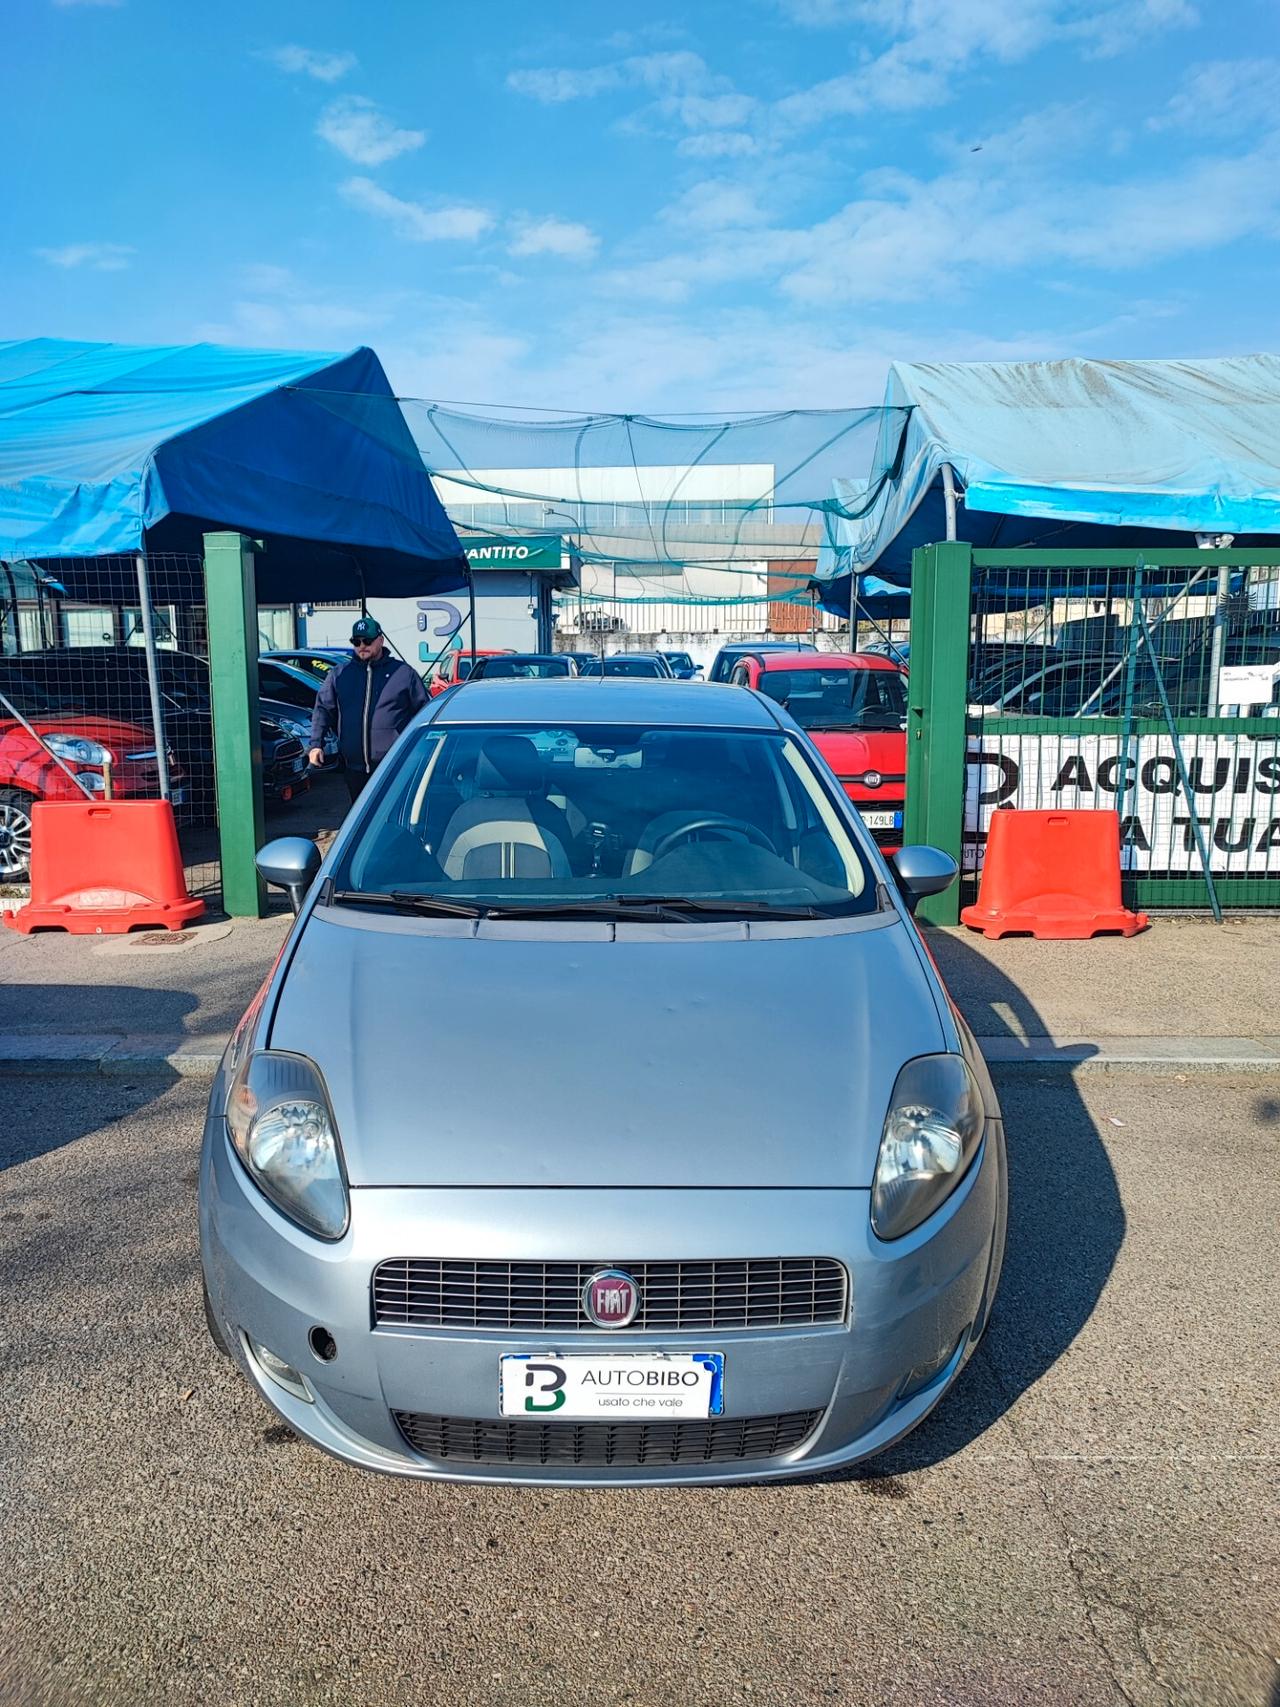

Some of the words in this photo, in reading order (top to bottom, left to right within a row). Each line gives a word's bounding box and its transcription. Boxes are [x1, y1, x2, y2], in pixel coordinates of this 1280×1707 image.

[464, 546, 528, 559] ANTITO
[1050, 755, 1280, 797] ACQUIS
[1172, 816, 1280, 852] TUA
[597, 1288, 629, 1314] FIAT
[581, 1369, 699, 1387] AUTOBIBO
[598, 1397, 634, 1408] usato
[635, 1396, 656, 1408] che
[657, 1397, 683, 1408] vale
